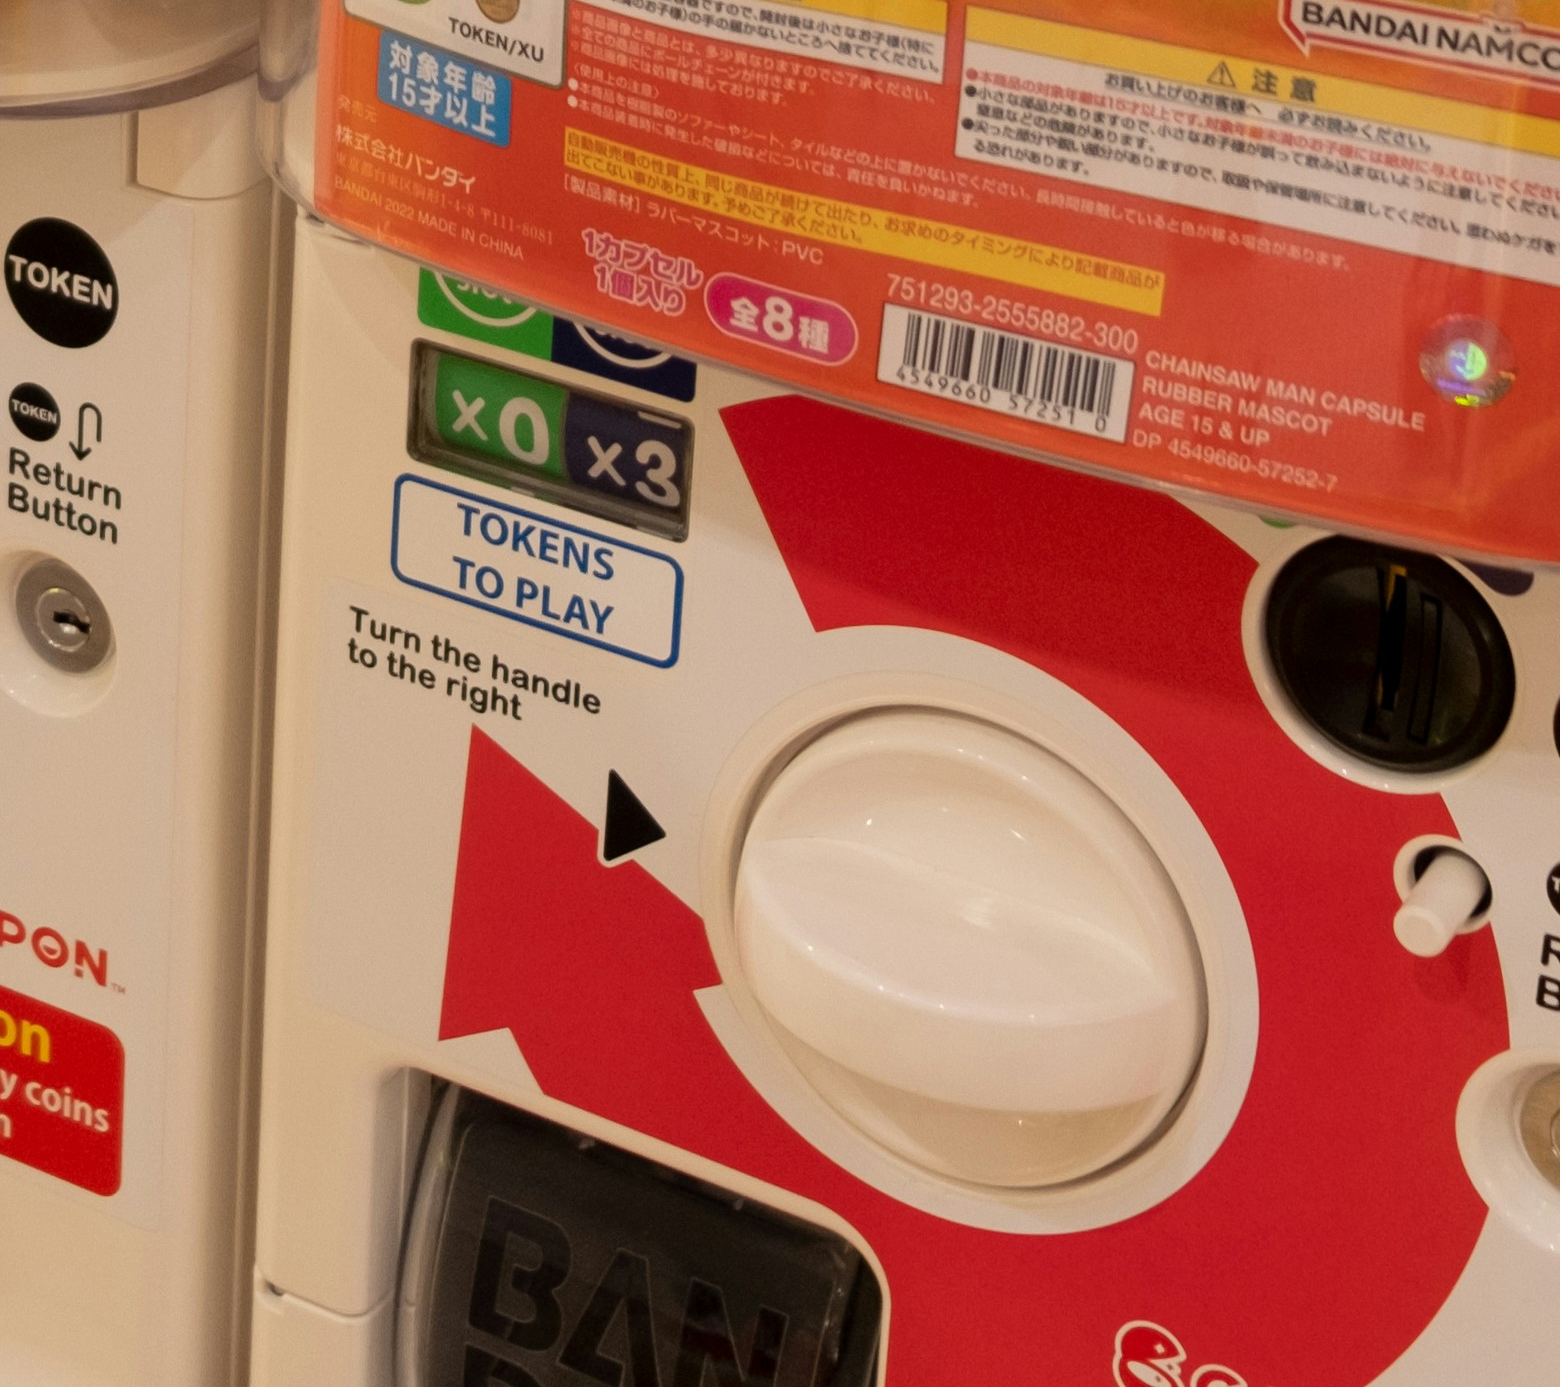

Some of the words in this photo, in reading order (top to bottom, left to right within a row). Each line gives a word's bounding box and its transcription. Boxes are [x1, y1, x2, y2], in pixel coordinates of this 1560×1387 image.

[387, 39, 497, 104] 対象年齢
[448, 16, 544, 64] TOKEN/XU
[387, 70, 497, 140] 15才以上
[336, 124, 476, 194] 株式会社バンダイ
[7, 253, 114, 312] TOKEN
[582, 228, 704, 289] 1カプセル
[594, 261, 686, 317] 1個入り
[728, 295, 831, 356] 全8種
[886, 272, 1139, 355] 751293-2555882-300
[11, 398, 58, 426] TOKEN
[1138, 402, 1187, 432] AGE
[1191, 413, 1215, 437] 15
[1218, 419, 1234, 441] &
[1141, 376, 1234, 413] RUBBER
[1237, 398, 1333, 437] MASCOT
[1144, 350, 1262, 393] CHAINSAW
[1265, 377, 1317, 408] MAN
[1321, 391, 1427, 433] CAPSULE
[9, 447, 122, 511] Return
[7, 482, 119, 544] Button
[456, 501, 615, 581] TOKENS
[452, 554, 505, 601] TO
[515, 582, 615, 636] PLAY
[347, 637, 380, 671] to
[387, 649, 438, 691] the
[445, 674, 523, 722] right
[348, 605, 422, 654] Turn
[430, 624, 482, 674] the
[491, 654, 602, 715] handle
[25, 1082, 110, 1134] coins
